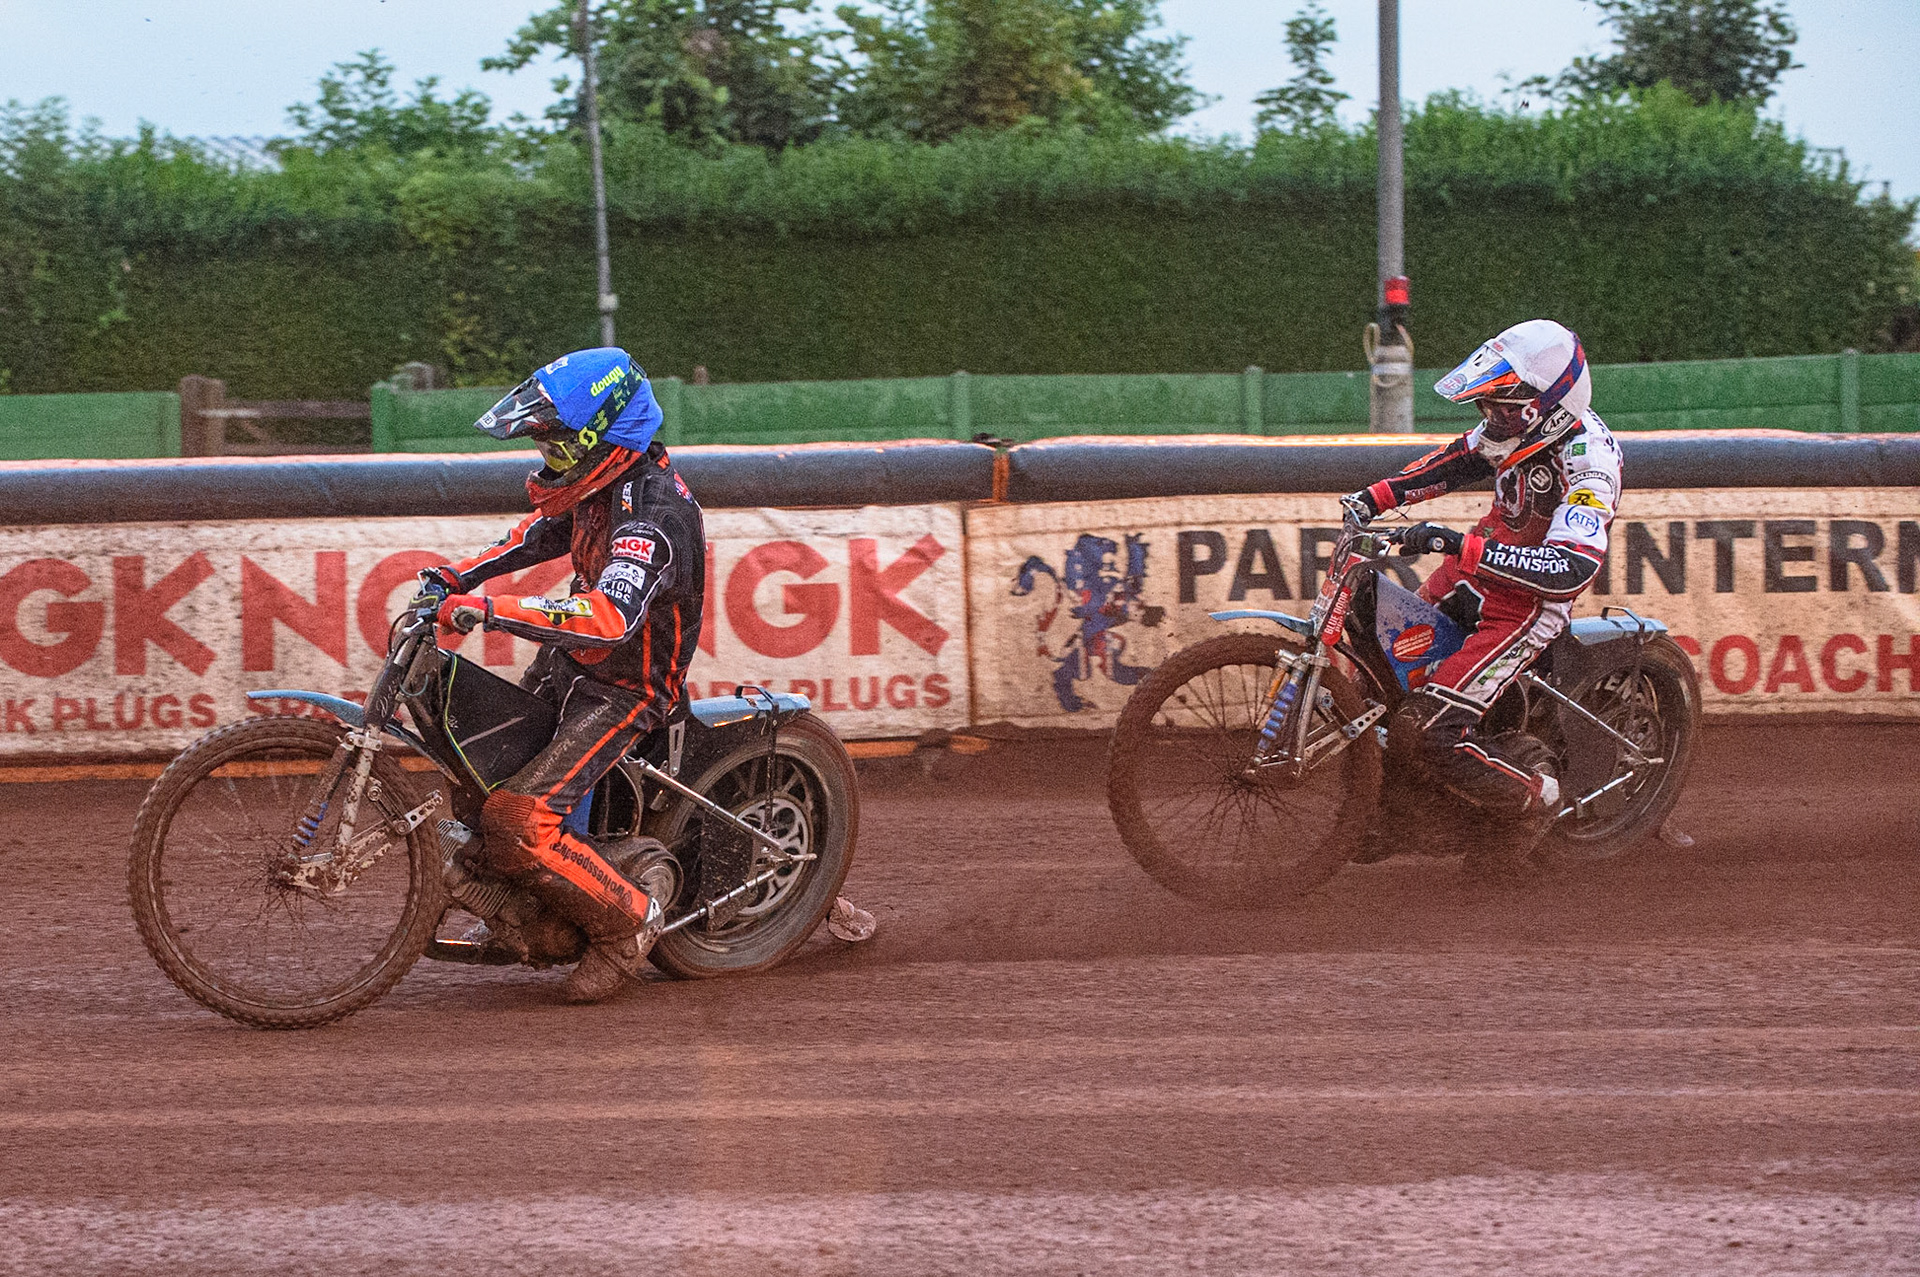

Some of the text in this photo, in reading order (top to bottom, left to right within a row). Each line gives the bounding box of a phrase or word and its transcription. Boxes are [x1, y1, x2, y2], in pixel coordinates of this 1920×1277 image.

[591, 366, 625, 397] dougy
[614, 539, 652, 555] NGK
[1486, 549, 1570, 574] TRANSPOR
[604, 587, 631, 605] KIPS
[697, 533, 950, 659] GK
[1324, 614, 1339, 634] BLUE
[1333, 591, 1348, 615] DOOR
[790, 673, 952, 711] PLUGS
[53, 693, 216, 732] PLUGS
